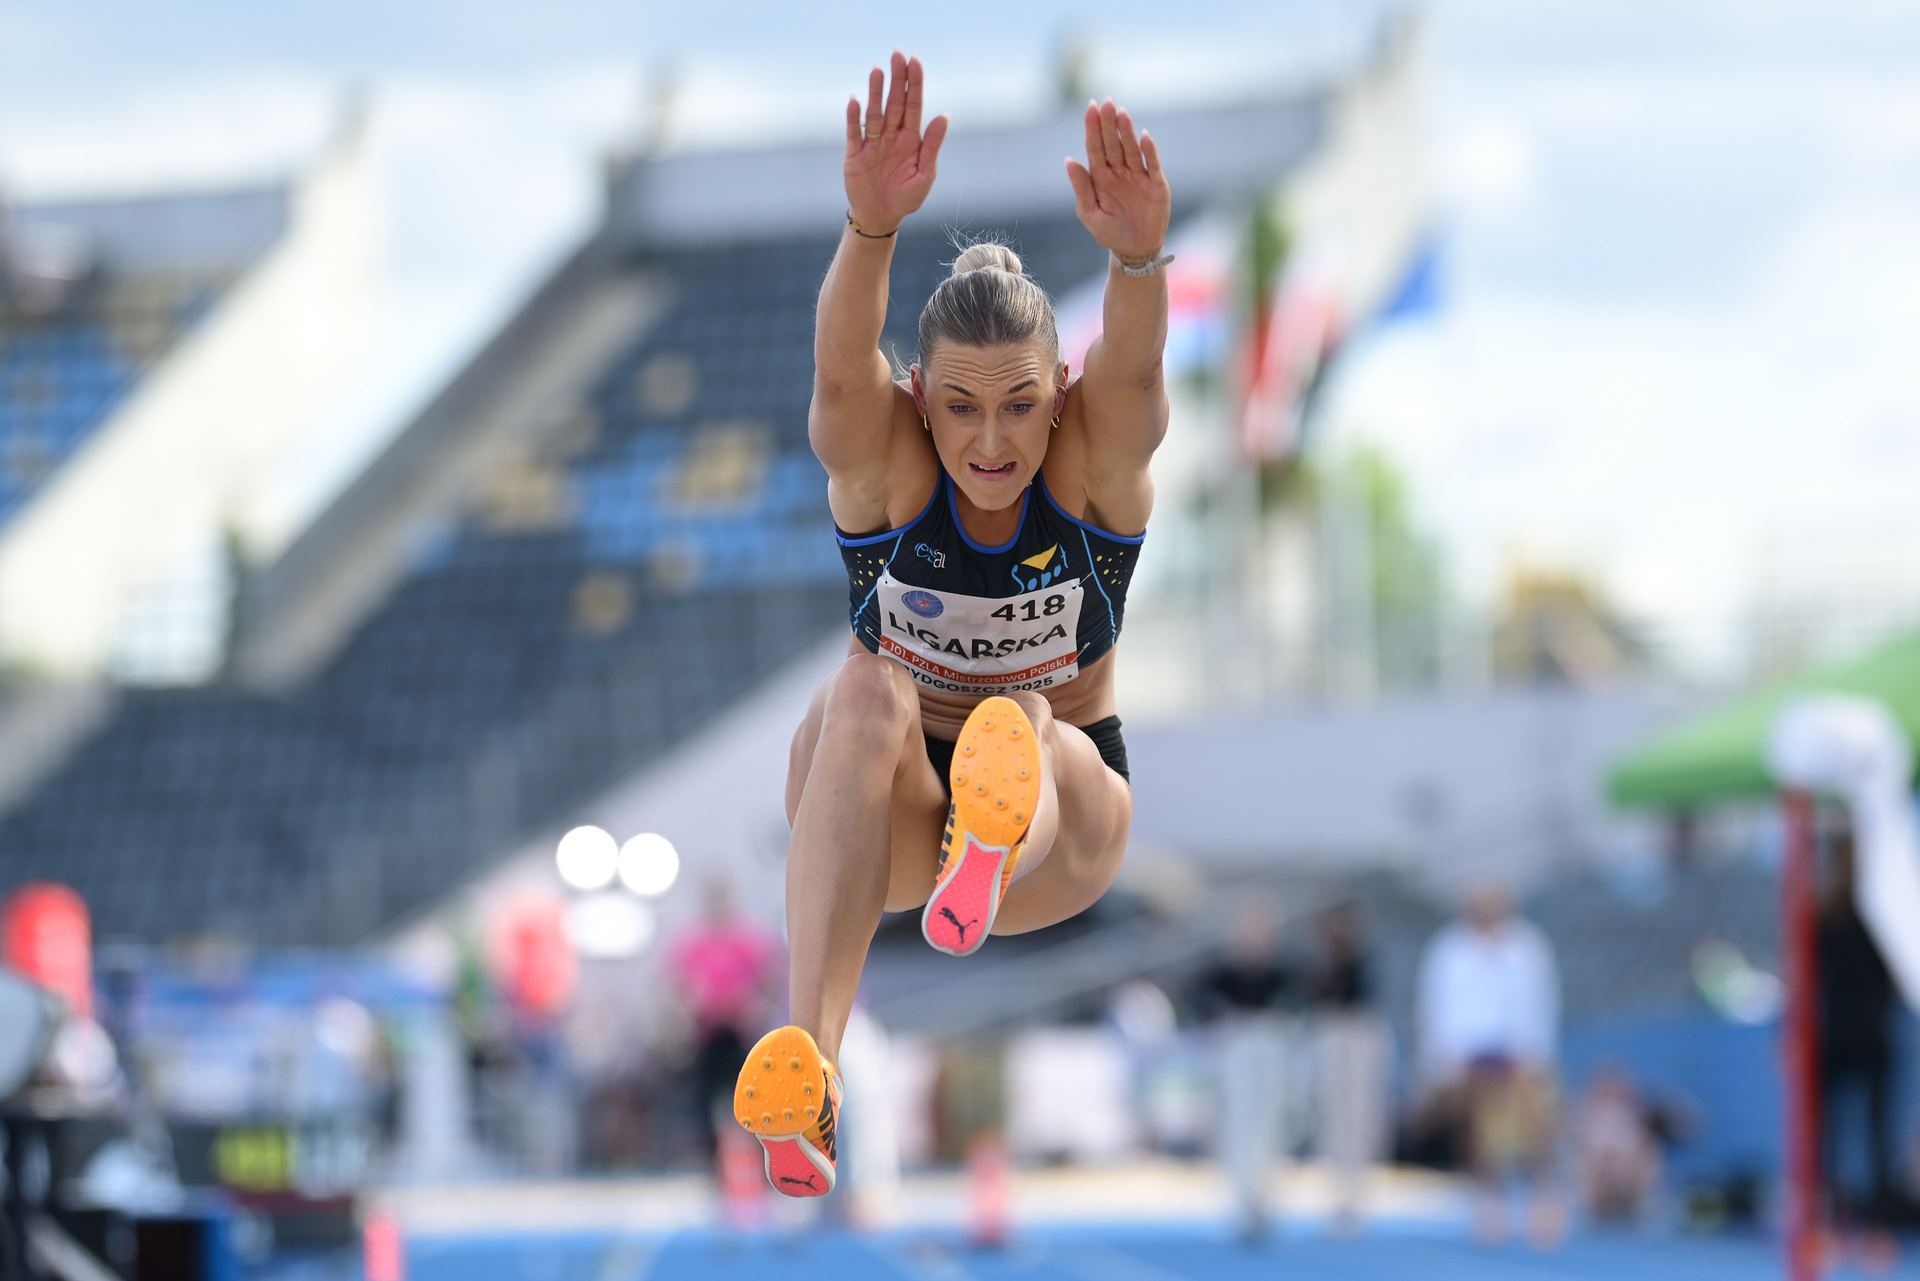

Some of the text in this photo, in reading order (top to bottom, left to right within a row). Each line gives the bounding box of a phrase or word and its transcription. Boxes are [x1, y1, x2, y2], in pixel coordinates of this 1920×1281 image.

[1011, 543, 1069, 597] Sopot
[990, 594, 1066, 622] 418
[888, 610, 1068, 660] LIGARSKA
[889, 642, 1067, 684] 101. PZLA Mistrzostwa Polski
[903, 664, 1007, 694] YDGOSZCZ
